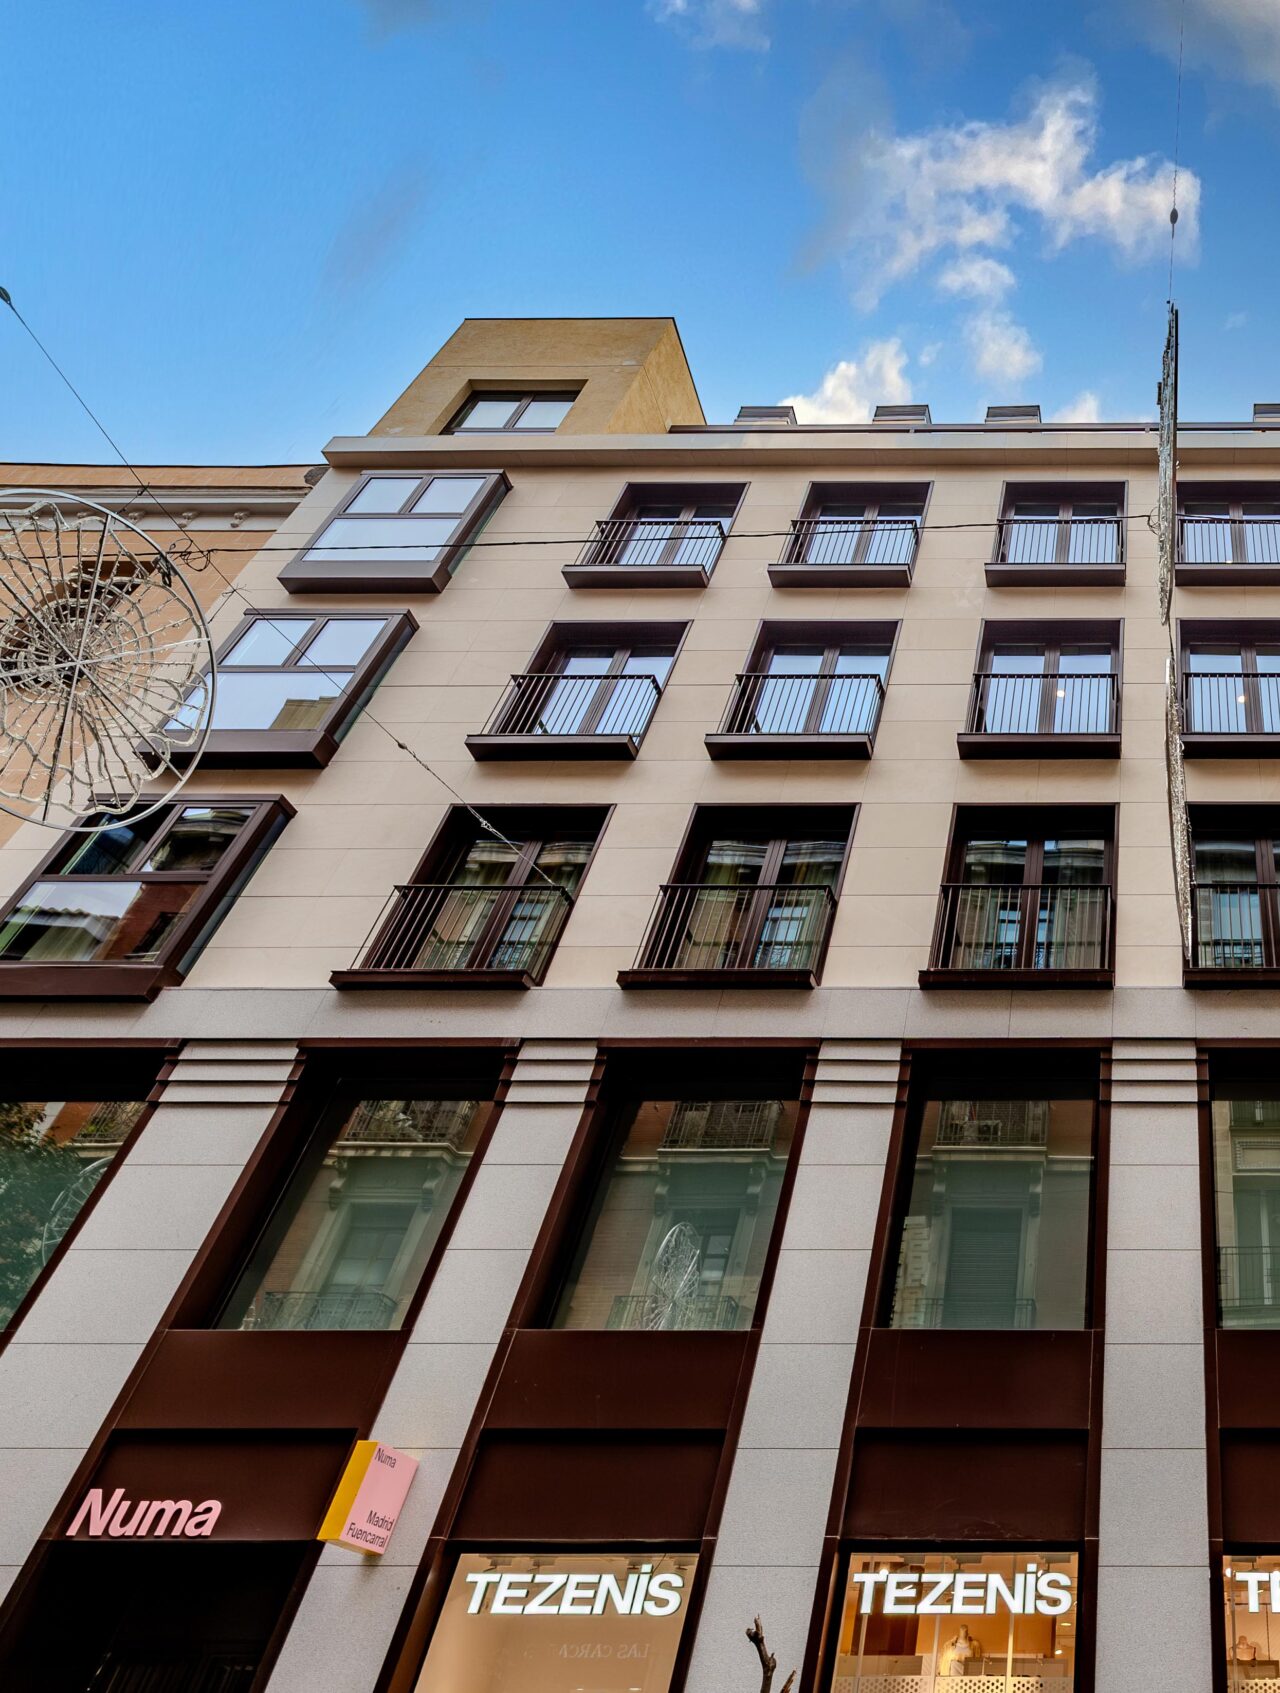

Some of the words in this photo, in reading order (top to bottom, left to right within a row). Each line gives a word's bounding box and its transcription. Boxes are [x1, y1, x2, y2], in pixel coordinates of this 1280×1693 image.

[374, 1448, 397, 1468] Numa
[65, 1488, 223, 1537] Numa
[366, 1510, 395, 1532] Madrid
[346, 1522, 389, 1548] Fuencarral
